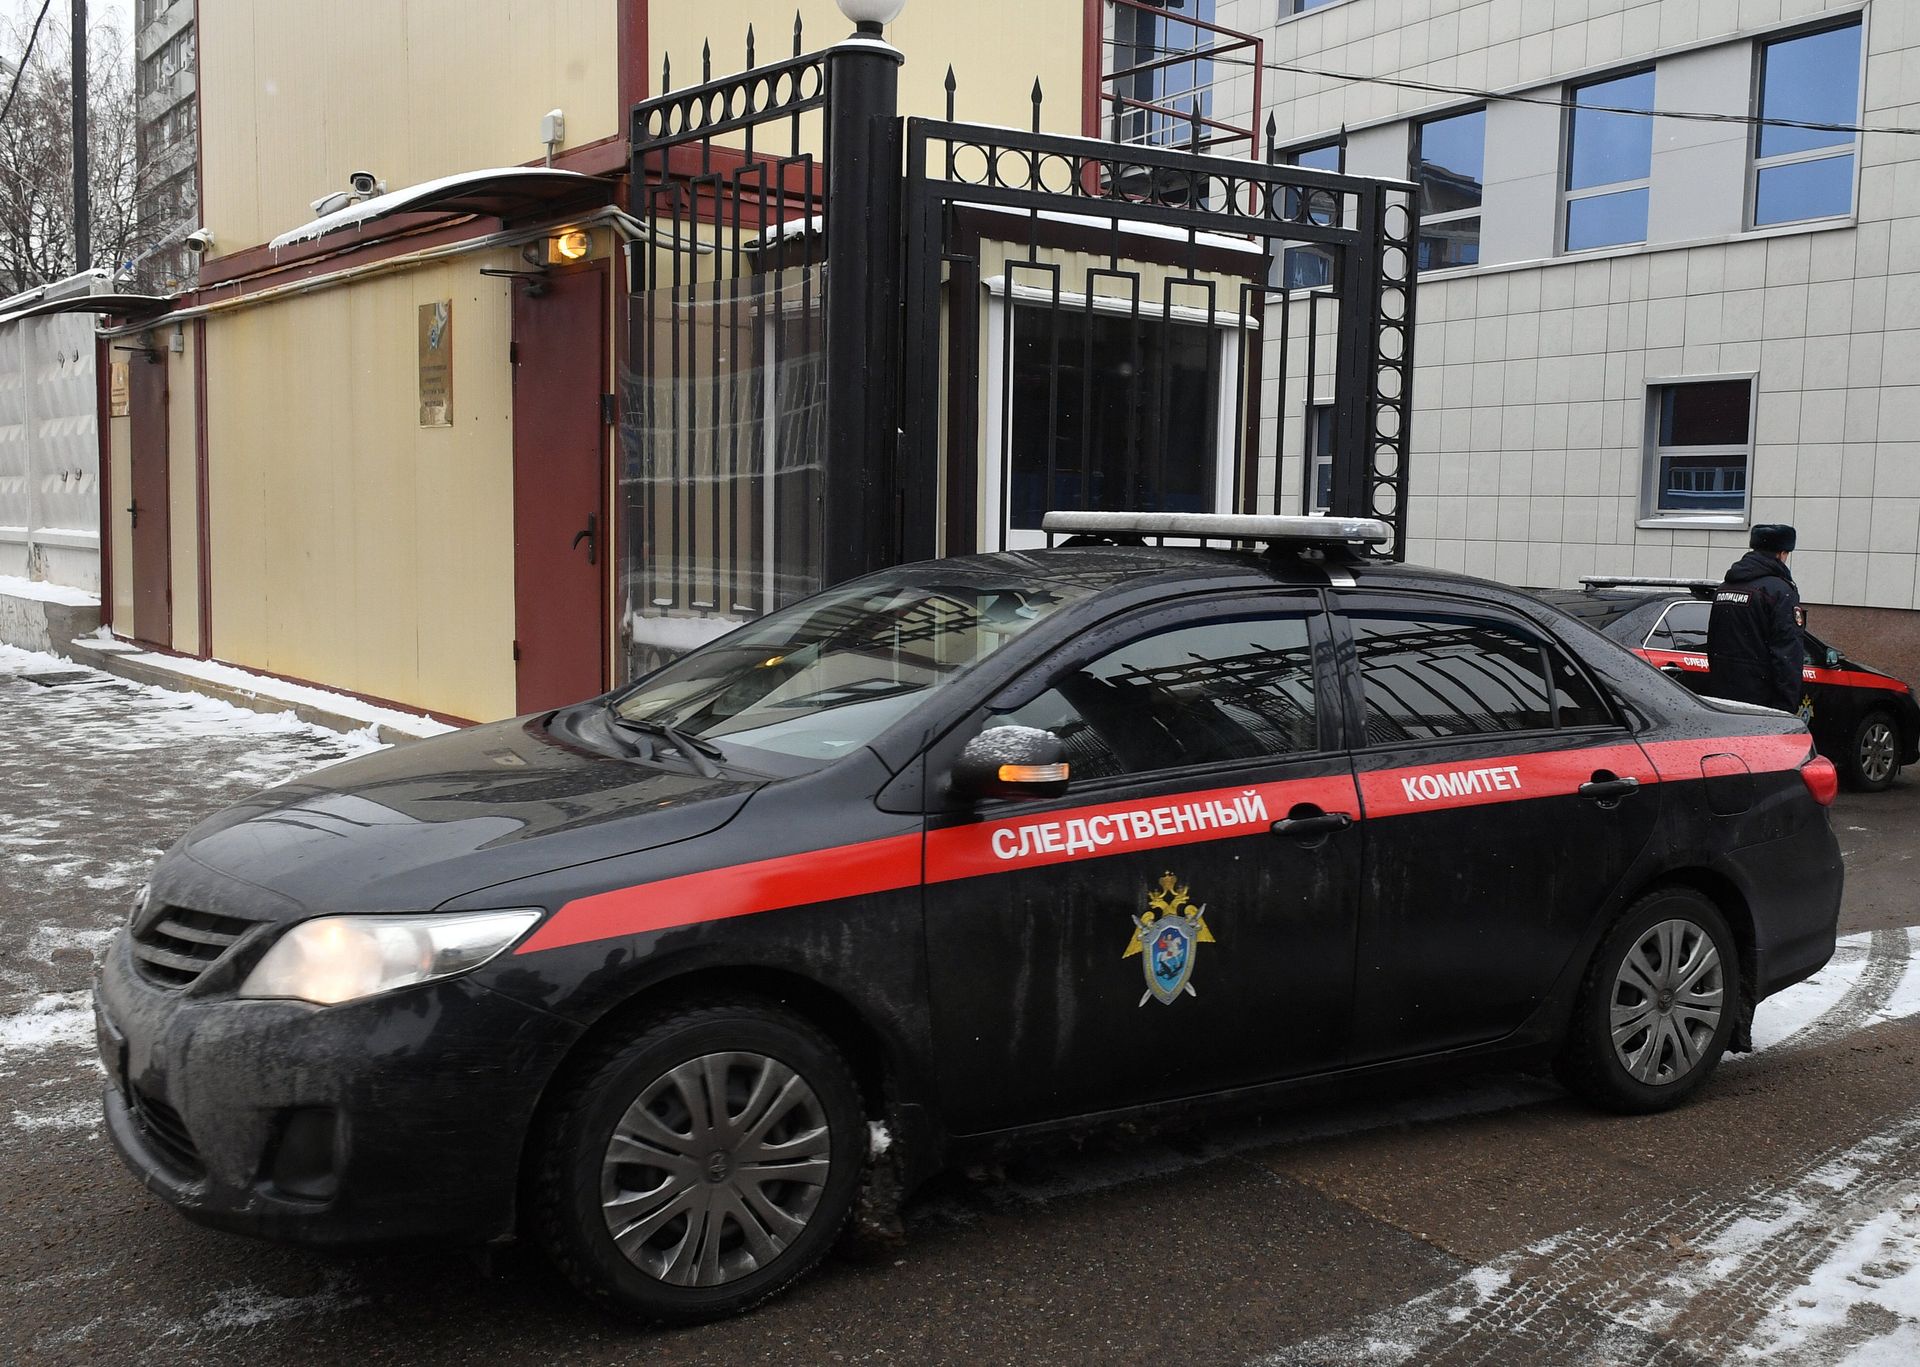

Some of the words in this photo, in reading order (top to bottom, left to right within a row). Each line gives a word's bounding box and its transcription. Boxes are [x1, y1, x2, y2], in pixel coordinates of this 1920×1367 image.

[1716, 593, 1749, 603] ПОЛИЦИЯ
[1683, 656, 1709, 669] СЛЕД
[992, 790, 1268, 860] СЛЕДСТВЕННЫЙ
[1401, 765, 1522, 802] КОМИТЕТ
